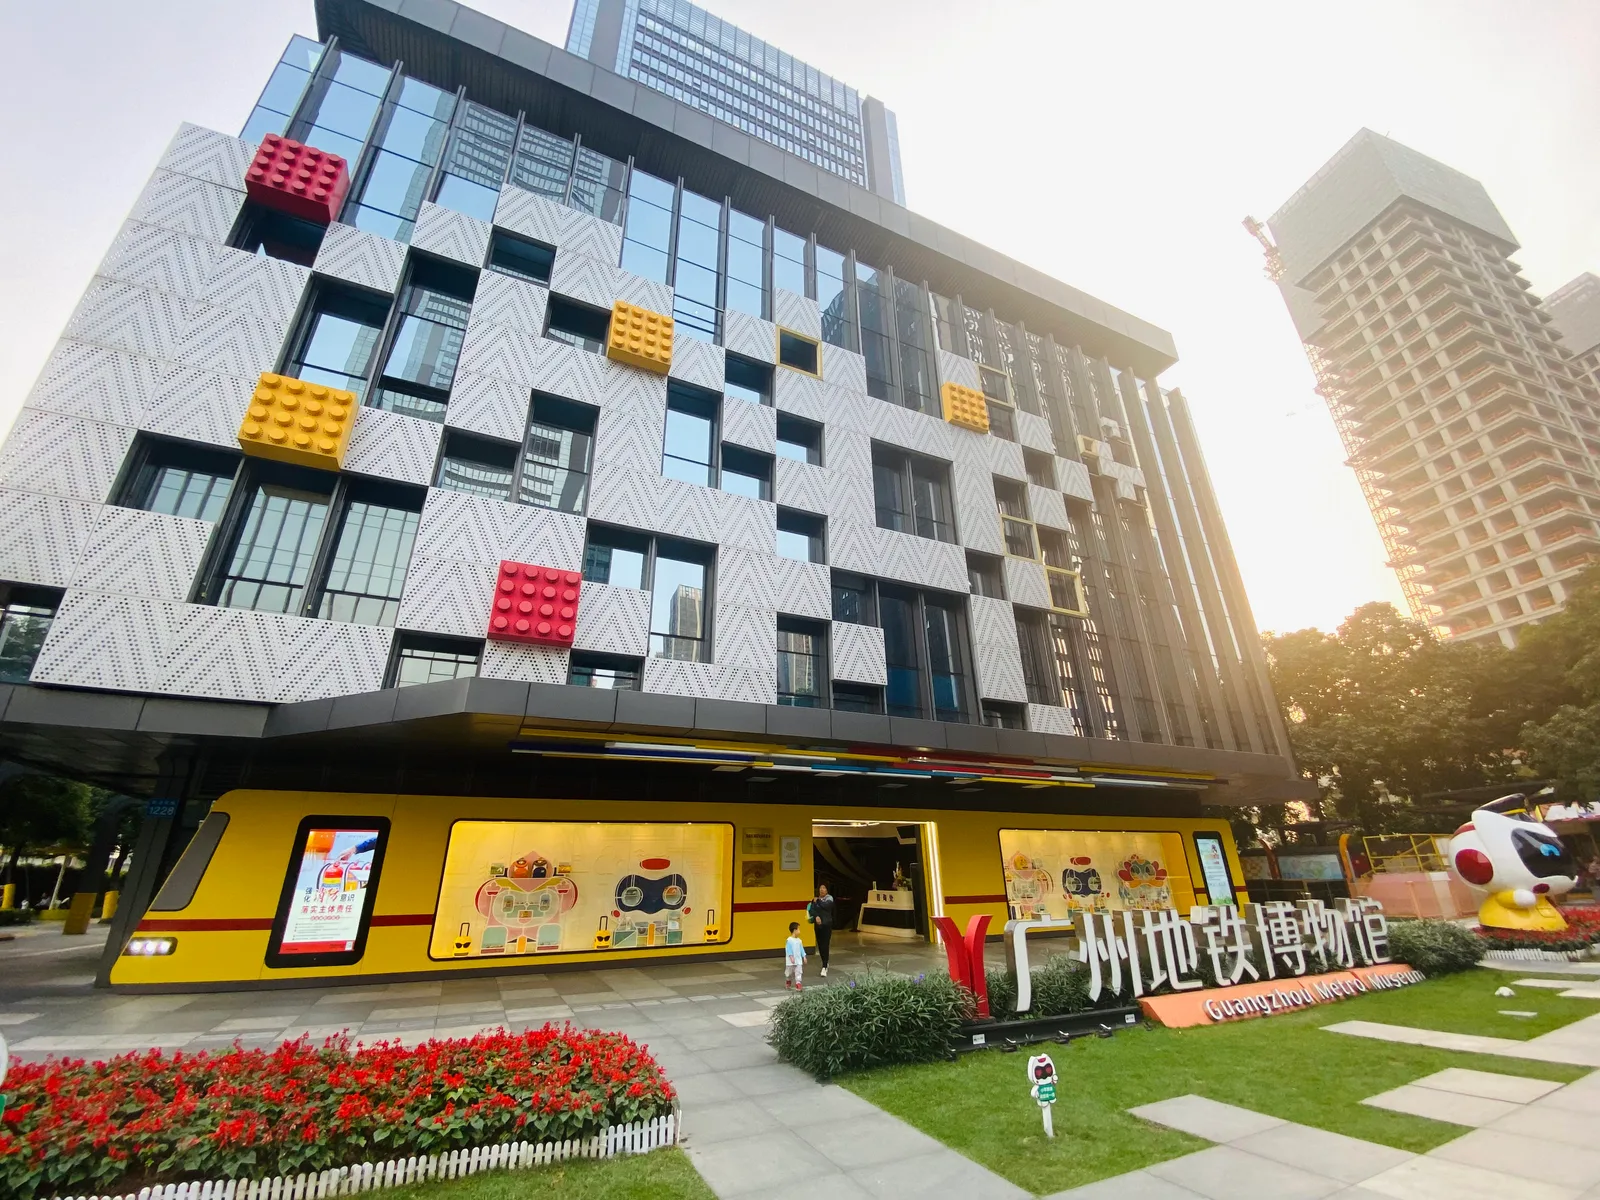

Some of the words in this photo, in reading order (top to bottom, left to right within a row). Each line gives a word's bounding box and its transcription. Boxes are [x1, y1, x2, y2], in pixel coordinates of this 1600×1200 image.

[150, 806, 174, 815] 1228
[301, 904, 353, 914] 落实主体责任
[1004, 898, 1391, 1012] 广州地铁博物馆
[1205, 986, 1313, 1020] Guangzhou
[1314, 978, 1367, 1000] Metro
[1368, 969, 1427, 990] Museum
